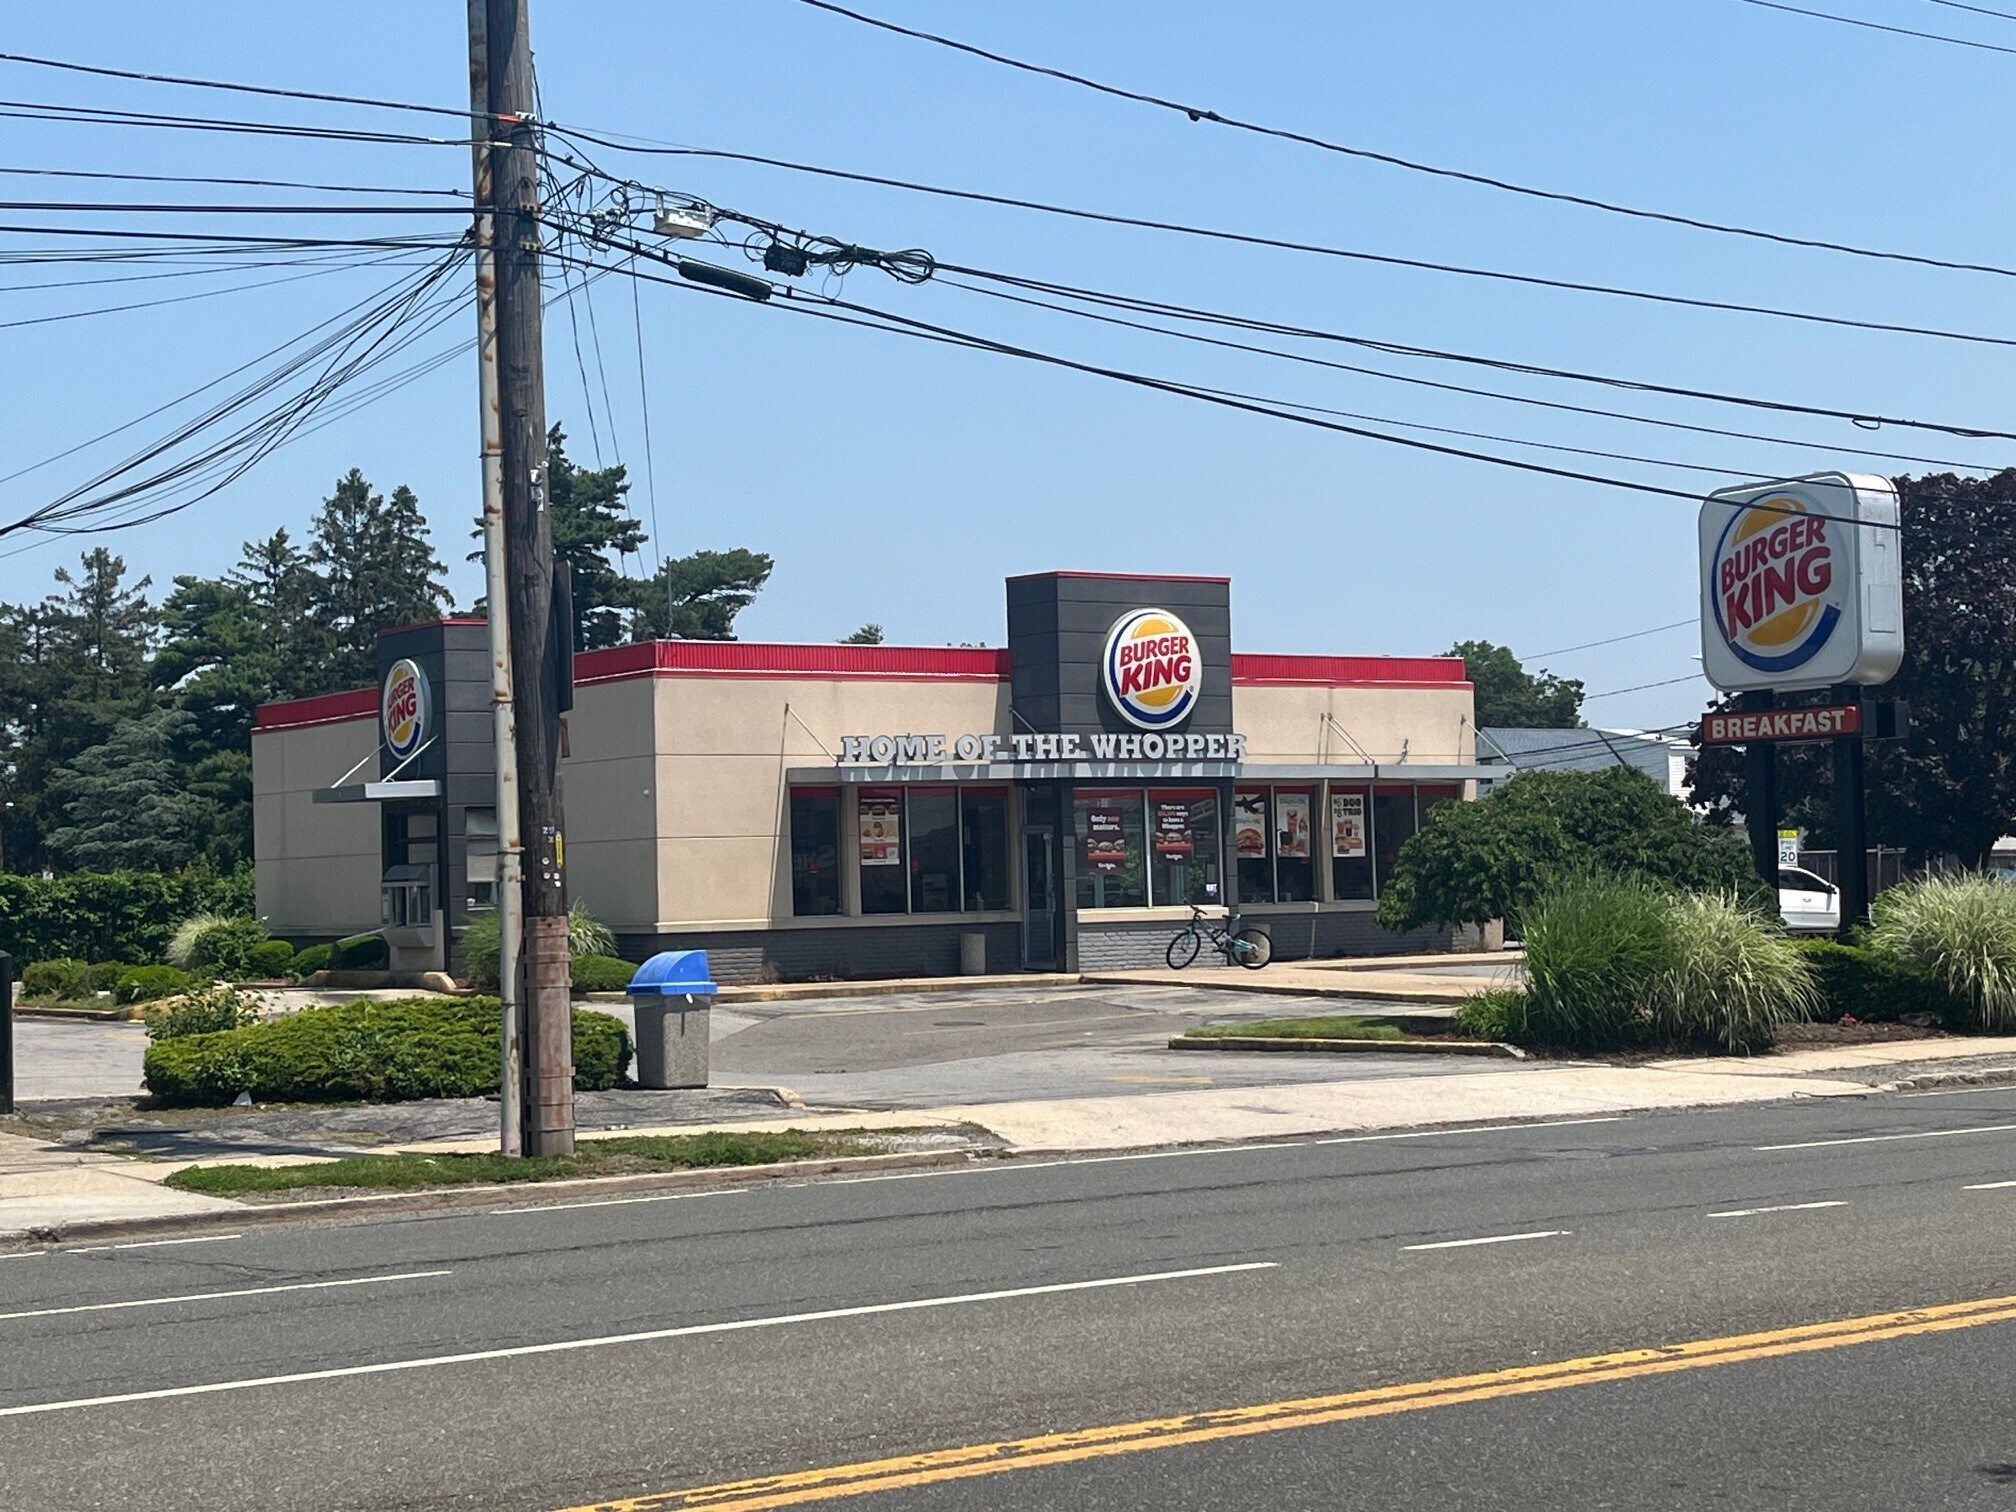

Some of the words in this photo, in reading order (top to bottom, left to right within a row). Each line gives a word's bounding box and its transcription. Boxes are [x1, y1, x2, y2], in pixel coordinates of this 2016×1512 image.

[1721, 516, 1826, 596] BURGER
[1726, 546, 1831, 641] KING
[1120, 636, 1189, 667] BURGER
[1121, 655, 1192, 696] KING
[1712, 710, 1845, 739] BREAKFAST
[842, 734, 946, 762] HOME
[956, 734, 1002, 761] OF
[1011, 734, 1081, 760] THE
[1090, 733, 1247, 759] WHOPPER
[1343, 797, 1361, 807] DUO
[1780, 851, 1796, 862] 20
